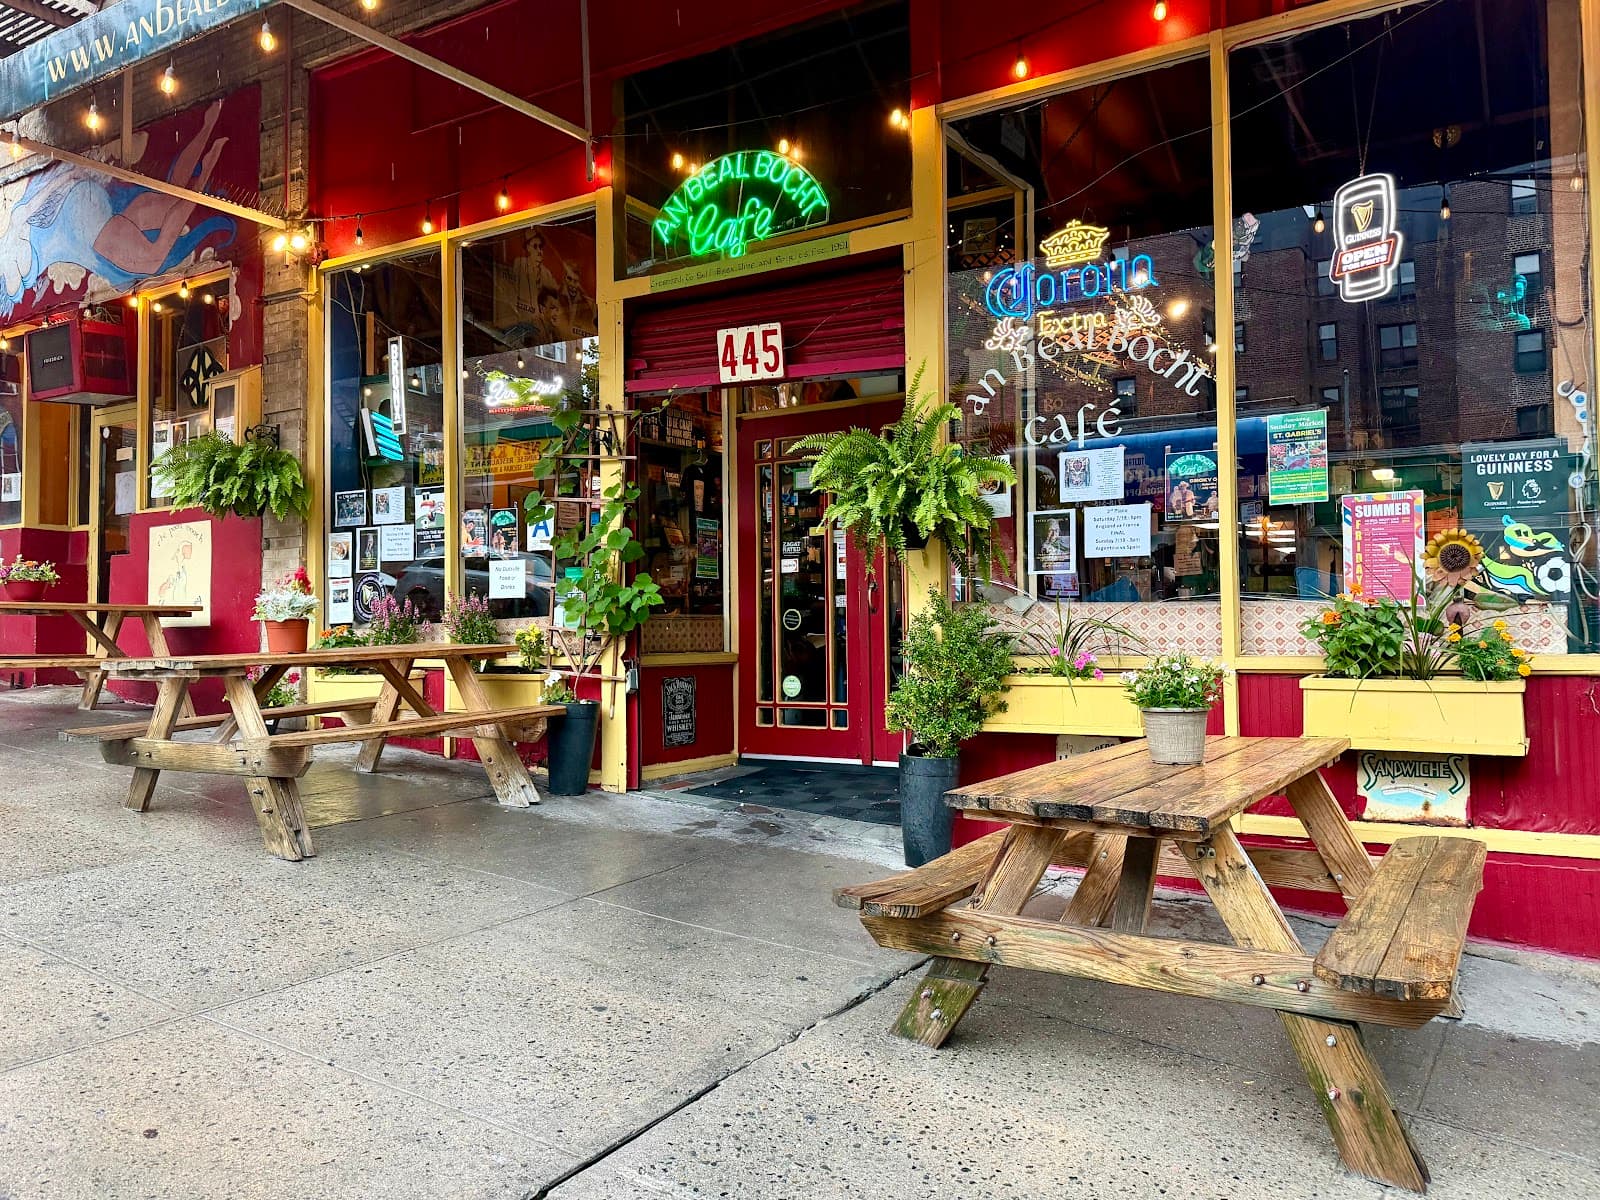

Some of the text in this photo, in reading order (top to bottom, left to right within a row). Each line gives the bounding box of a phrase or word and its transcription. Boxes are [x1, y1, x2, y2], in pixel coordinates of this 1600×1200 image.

[653, 151, 828, 244] AN BEAL BOCHT
[1345, 227, 1382, 245] GUINNESS
[1341, 243, 1389, 265] OPEN
[985, 254, 1160, 322] Corona
[1036, 310, 1107, 337] Extra
[720, 328, 781, 379] 445
[966, 368, 1007, 416] an
[1024, 398, 1124, 449] café
[1285, 428, 1322, 438] GABRIEL'S
[1470, 449, 1559, 463] LOVELY DAY FOR A
[1477, 459, 1553, 475] GUINNESS
[1355, 502, 1411, 518] SUMMER
[531, 519, 550, 538] A
[666, 722, 693, 733] WHISKEY
[1360, 752, 1466, 795] SANDWICHES
